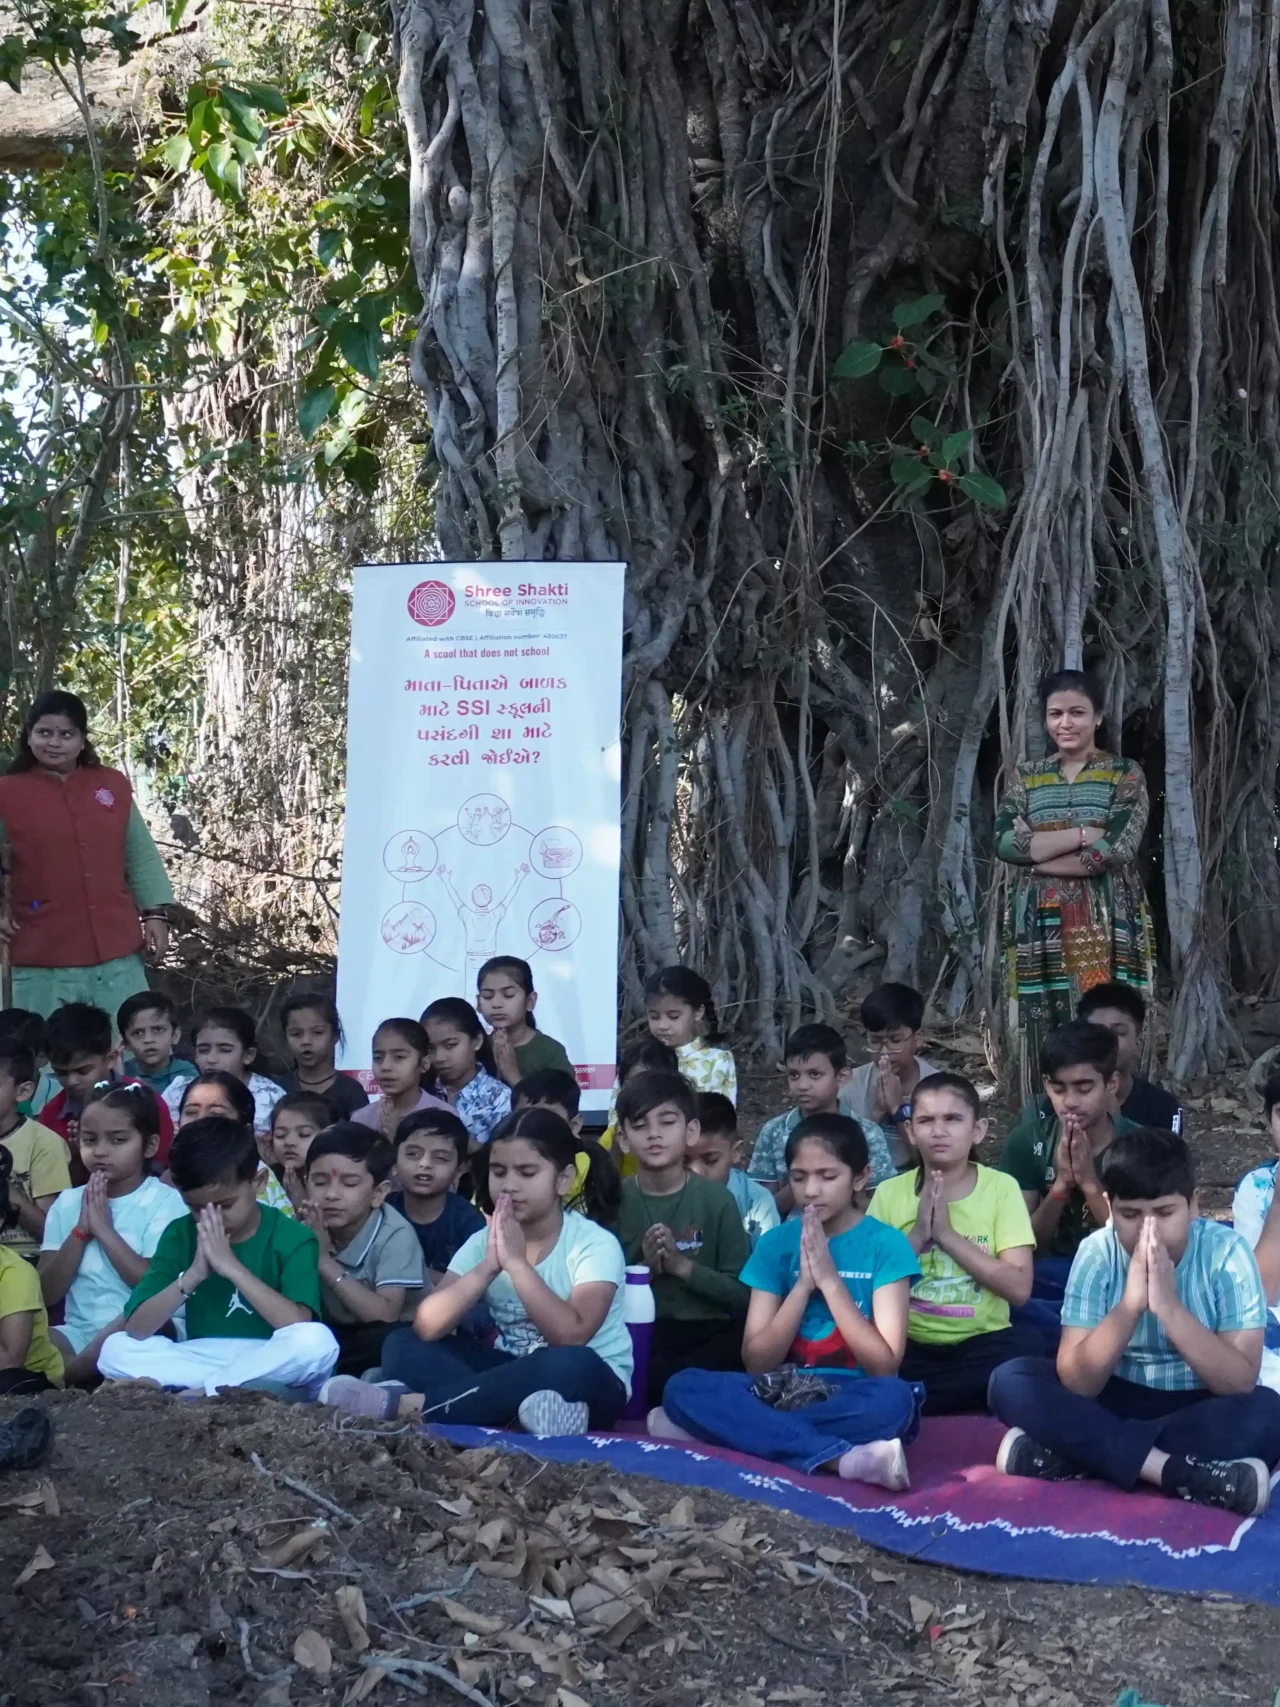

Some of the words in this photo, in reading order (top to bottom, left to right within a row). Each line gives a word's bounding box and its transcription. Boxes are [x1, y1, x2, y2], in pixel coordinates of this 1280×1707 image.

[464, 585, 512, 598] Shree
[517, 583, 569, 597] Shakti
[515, 598, 568, 606] INNOVATION
[424, 649, 430, 659] A
[433, 648, 457, 659] scool
[459, 648, 478, 658] that
[480, 647, 500, 658] does
[503, 647, 518, 657] not
[521, 646, 550, 657] school
[519, 677, 568, 690] બાળક
[419, 700, 450, 717] માટે
[456, 699, 490, 716] SSI
[417, 723, 480, 741] પસંદગી
[490, 727, 512, 740] શા
[522, 721, 553, 739] માટે
[428, 748, 470, 767] કરવી
[481, 747, 541, 765] જોઈએ?
[357, 1070, 375, 1081] CB
